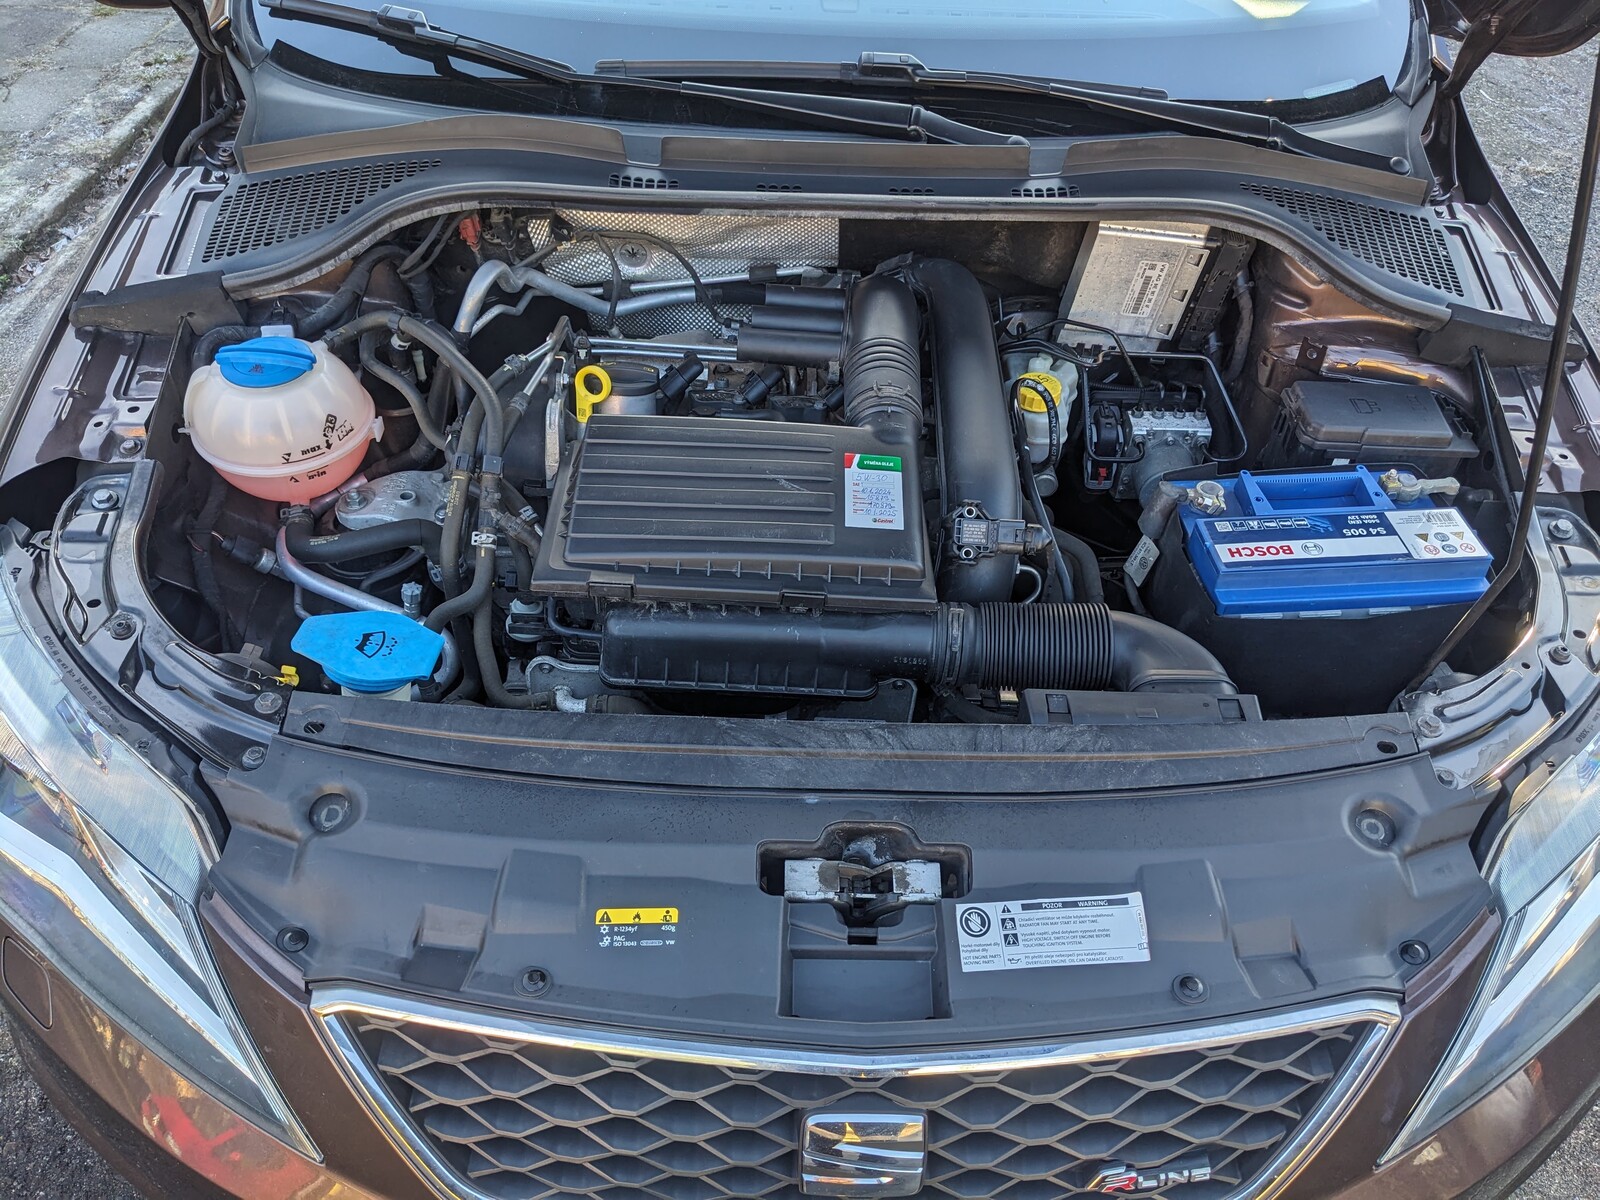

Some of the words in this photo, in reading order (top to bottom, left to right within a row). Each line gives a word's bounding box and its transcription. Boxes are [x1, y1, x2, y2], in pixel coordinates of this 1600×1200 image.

[301, 445, 322, 456] max
[308, 470, 327, 480] min
[1343, 528, 1367, 536] 005
[1227, 545, 1294, 558] BOSCH
